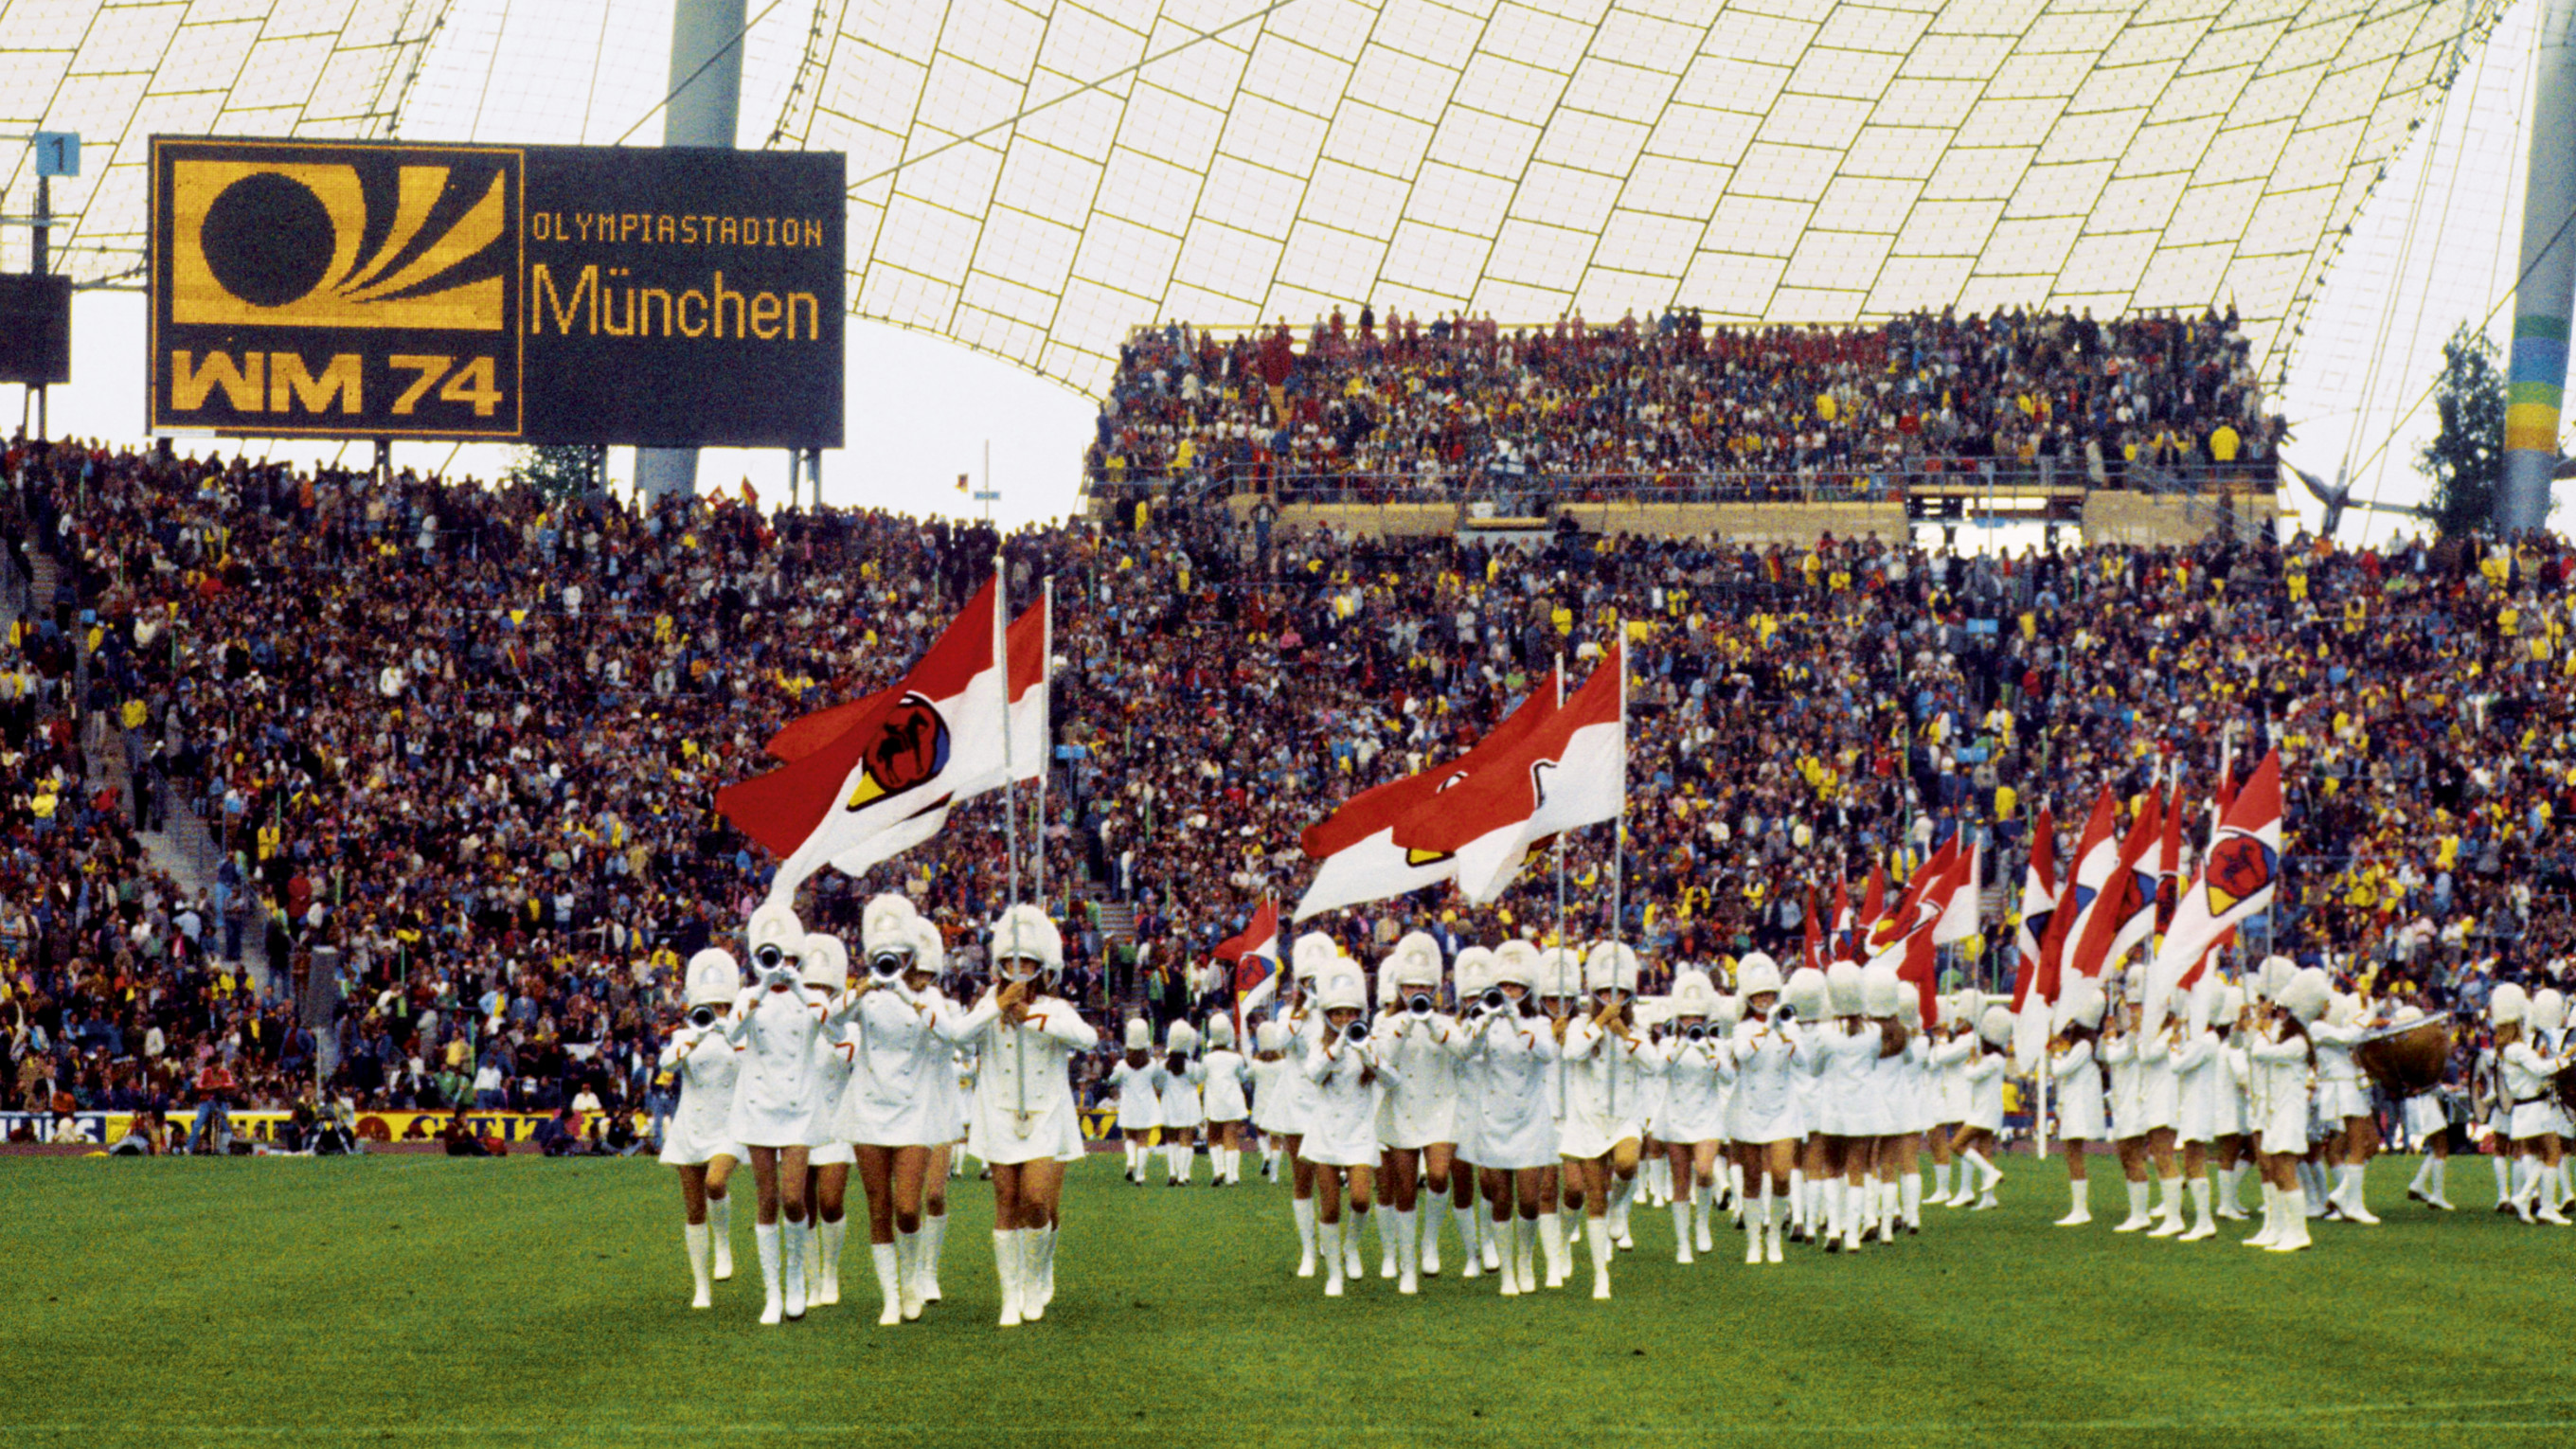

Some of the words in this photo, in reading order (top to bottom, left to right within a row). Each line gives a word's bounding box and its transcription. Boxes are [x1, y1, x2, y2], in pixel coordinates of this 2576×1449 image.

[51, 136, 64, 172] 1
[532, 212, 822, 247] OLYMPIASTADION
[531, 263, 819, 341] München
[171, 349, 362, 414] WM
[388, 354, 503, 417] 74
